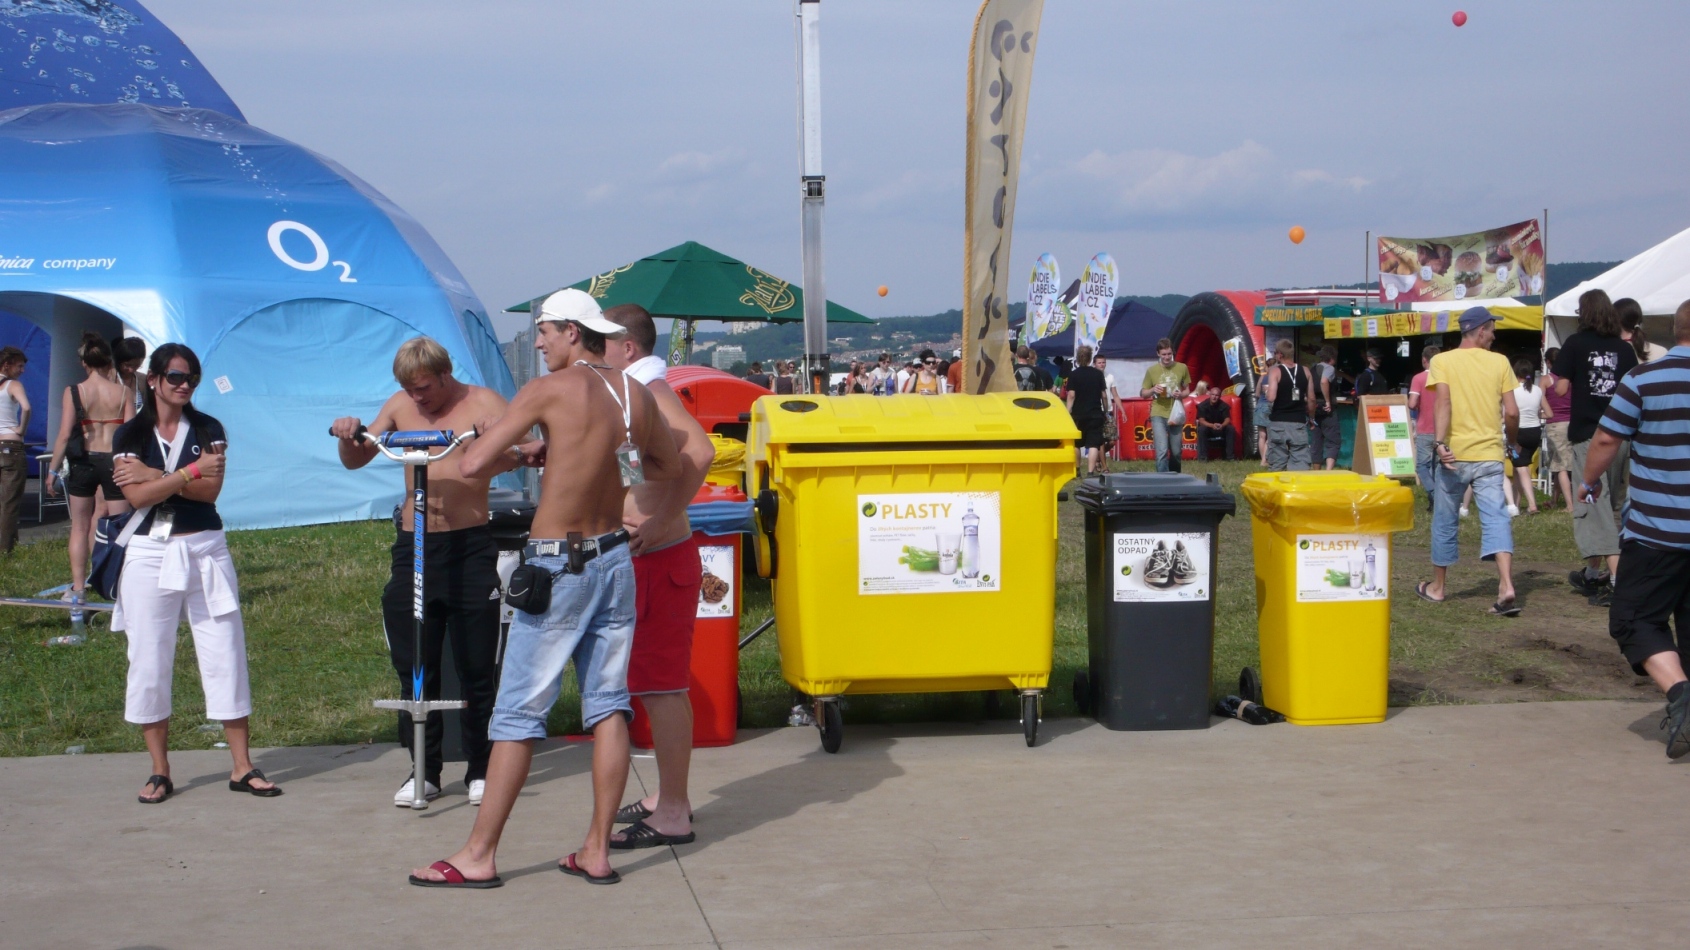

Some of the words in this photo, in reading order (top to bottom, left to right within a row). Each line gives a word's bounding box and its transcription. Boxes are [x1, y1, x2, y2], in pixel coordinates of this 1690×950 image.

[267, 220, 357, 283] O2
[43, 257, 117, 271] company
[1032, 271, 1050, 283] INDIE
[1085, 271, 1107, 285] INDIE
[1032, 283, 1057, 294] LABELS
[1085, 283, 1114, 298] LABELS
[881, 502, 953, 520] PLASTY
[1117, 536, 1155, 546] OSTATNÝ
[1312, 540, 1359, 551] PLASTY
[1117, 546, 1147, 554] ODPAD
[413, 512, 425, 624] MOTOSTIK
